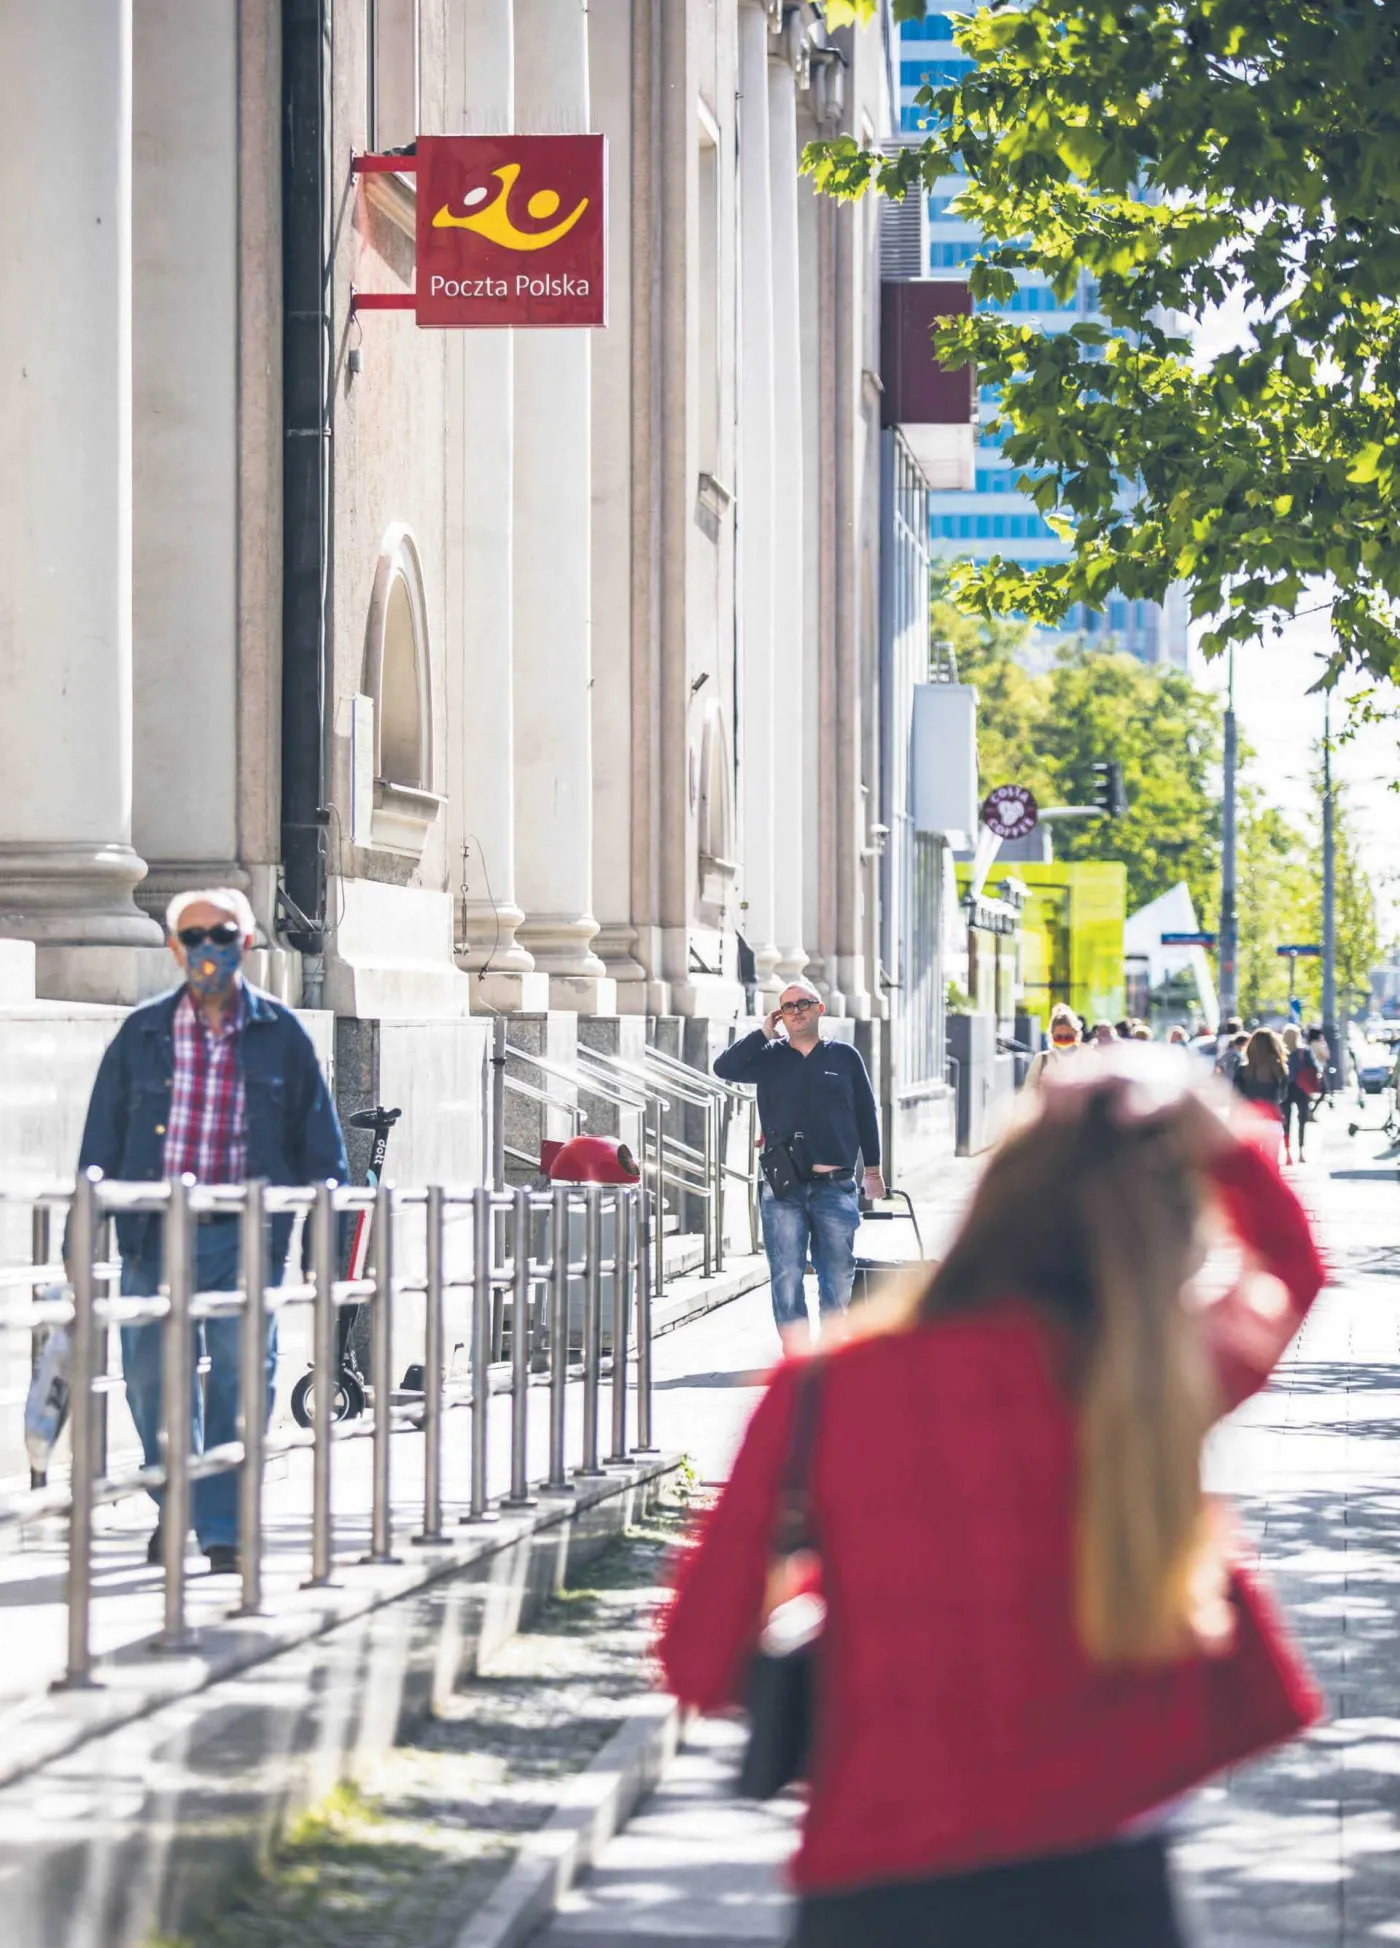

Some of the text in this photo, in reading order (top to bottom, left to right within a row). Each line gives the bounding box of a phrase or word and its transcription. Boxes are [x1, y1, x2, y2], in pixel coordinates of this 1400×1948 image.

[431, 274, 589, 297] Poczta Polska
[990, 786, 1030, 804] COSTA
[987, 817, 1035, 838] COFFEE
[373, 1139, 386, 1165] dott
